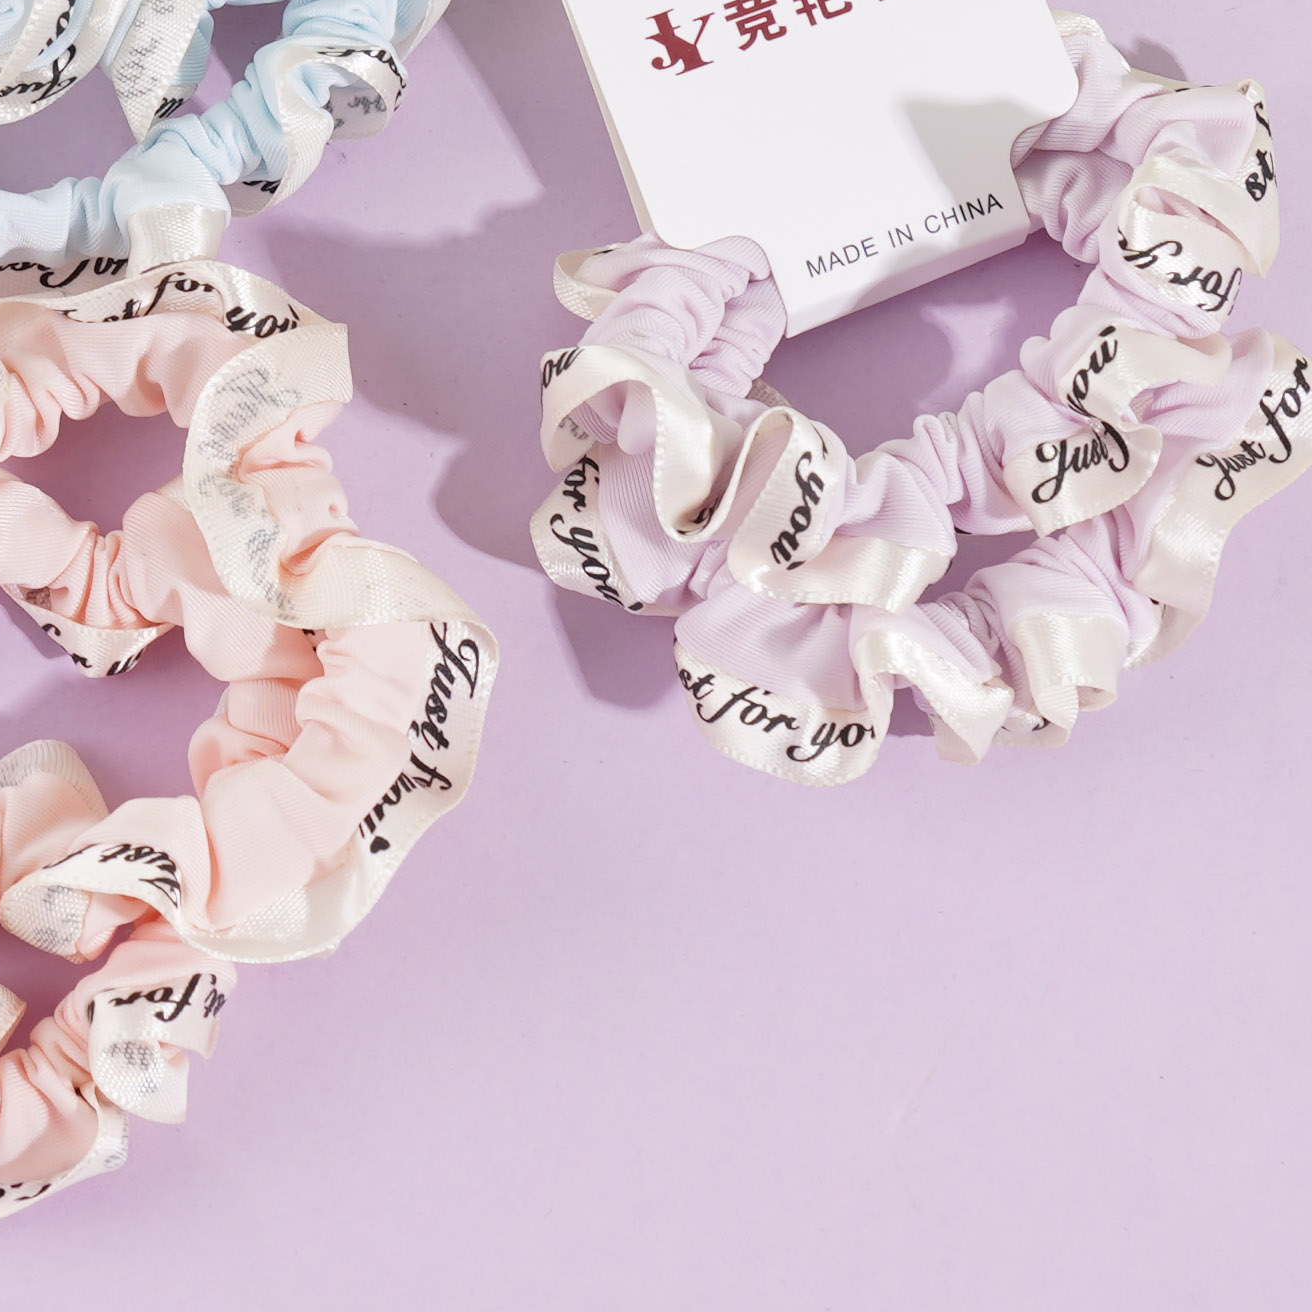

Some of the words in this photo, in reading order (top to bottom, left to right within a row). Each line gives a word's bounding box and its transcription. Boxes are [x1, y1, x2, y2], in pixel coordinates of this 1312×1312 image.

[807, 236, 879, 278] MADE
[888, 224, 914, 248] IN
[924, 193, 1004, 235] CHINA
[770, 450, 826, 570] you
[1196, 440, 1268, 501] Just
[421, 621, 481, 751] Just
[696, 687, 799, 732] for
[787, 721, 876, 763] yo
[107, 972, 218, 1022] for
